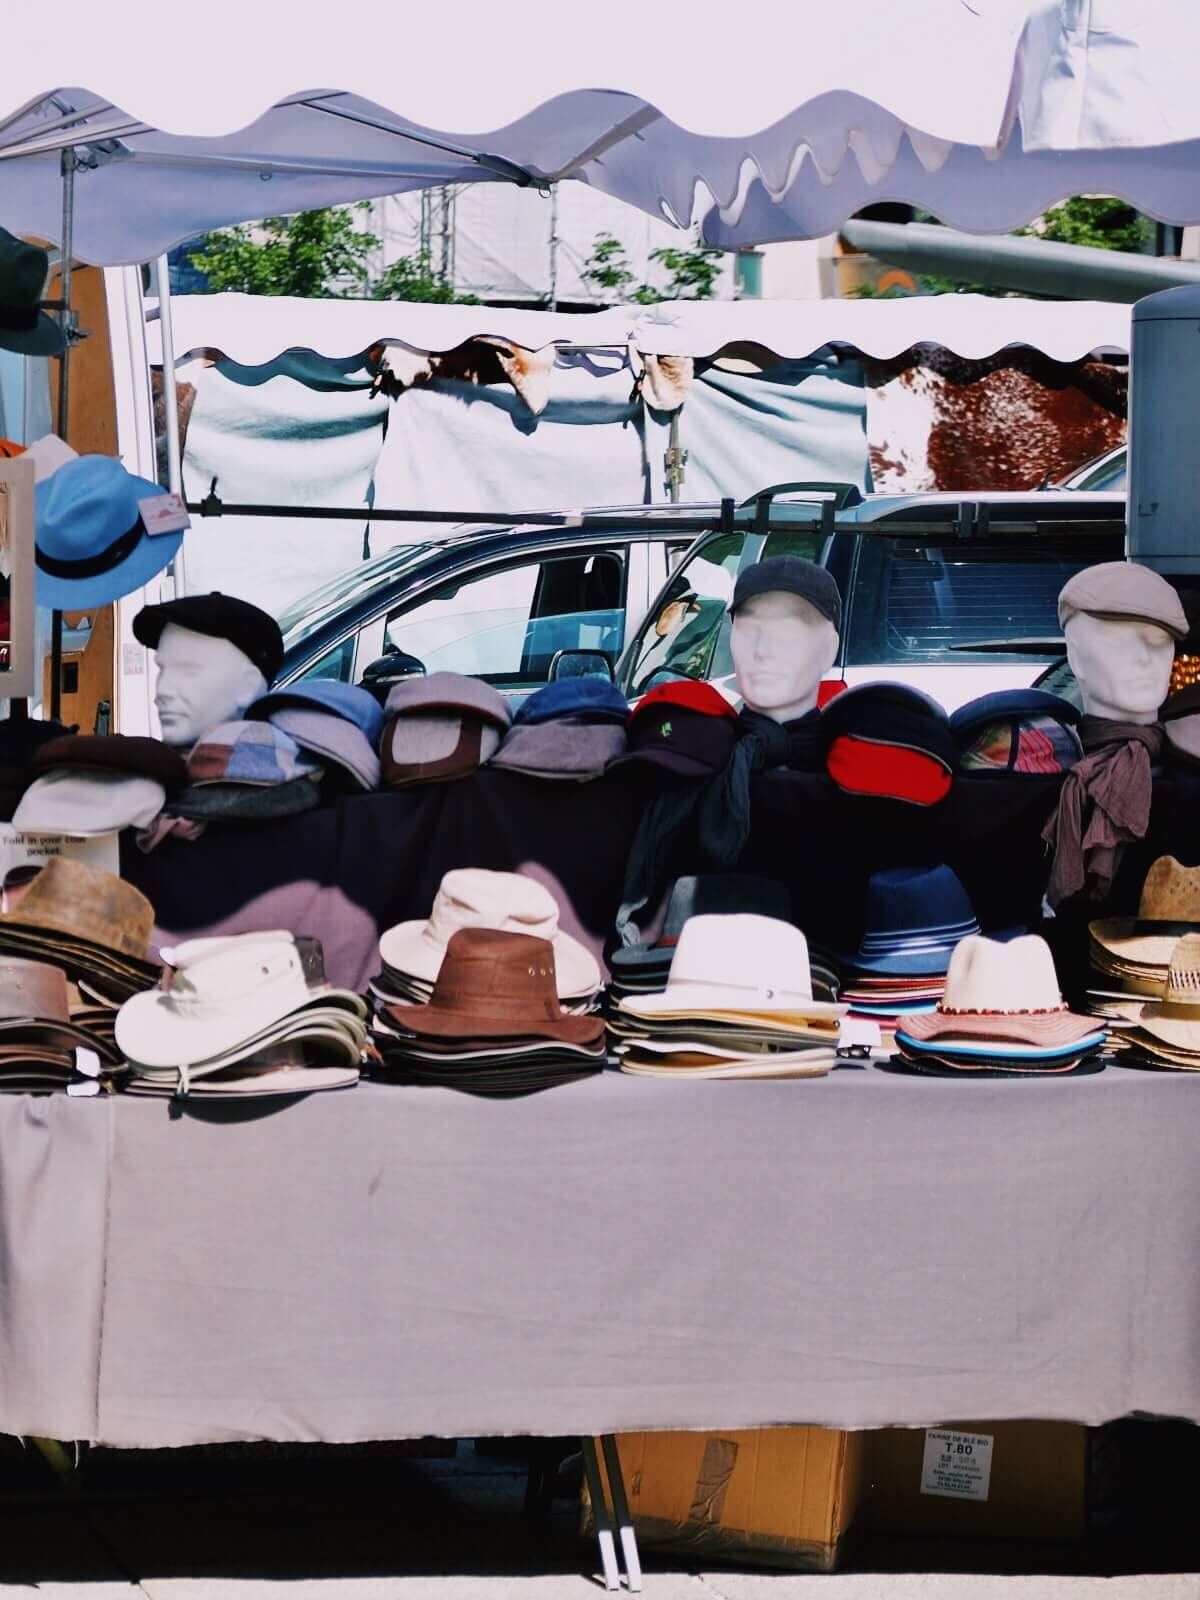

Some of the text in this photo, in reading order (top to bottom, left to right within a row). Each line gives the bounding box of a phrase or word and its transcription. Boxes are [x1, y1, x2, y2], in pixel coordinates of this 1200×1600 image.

[3, 835, 25, 845] Fold
[28, 835, 37, 845] in
[40, 836, 62, 847] your
[945, 1442, 973, 1455] T.80
